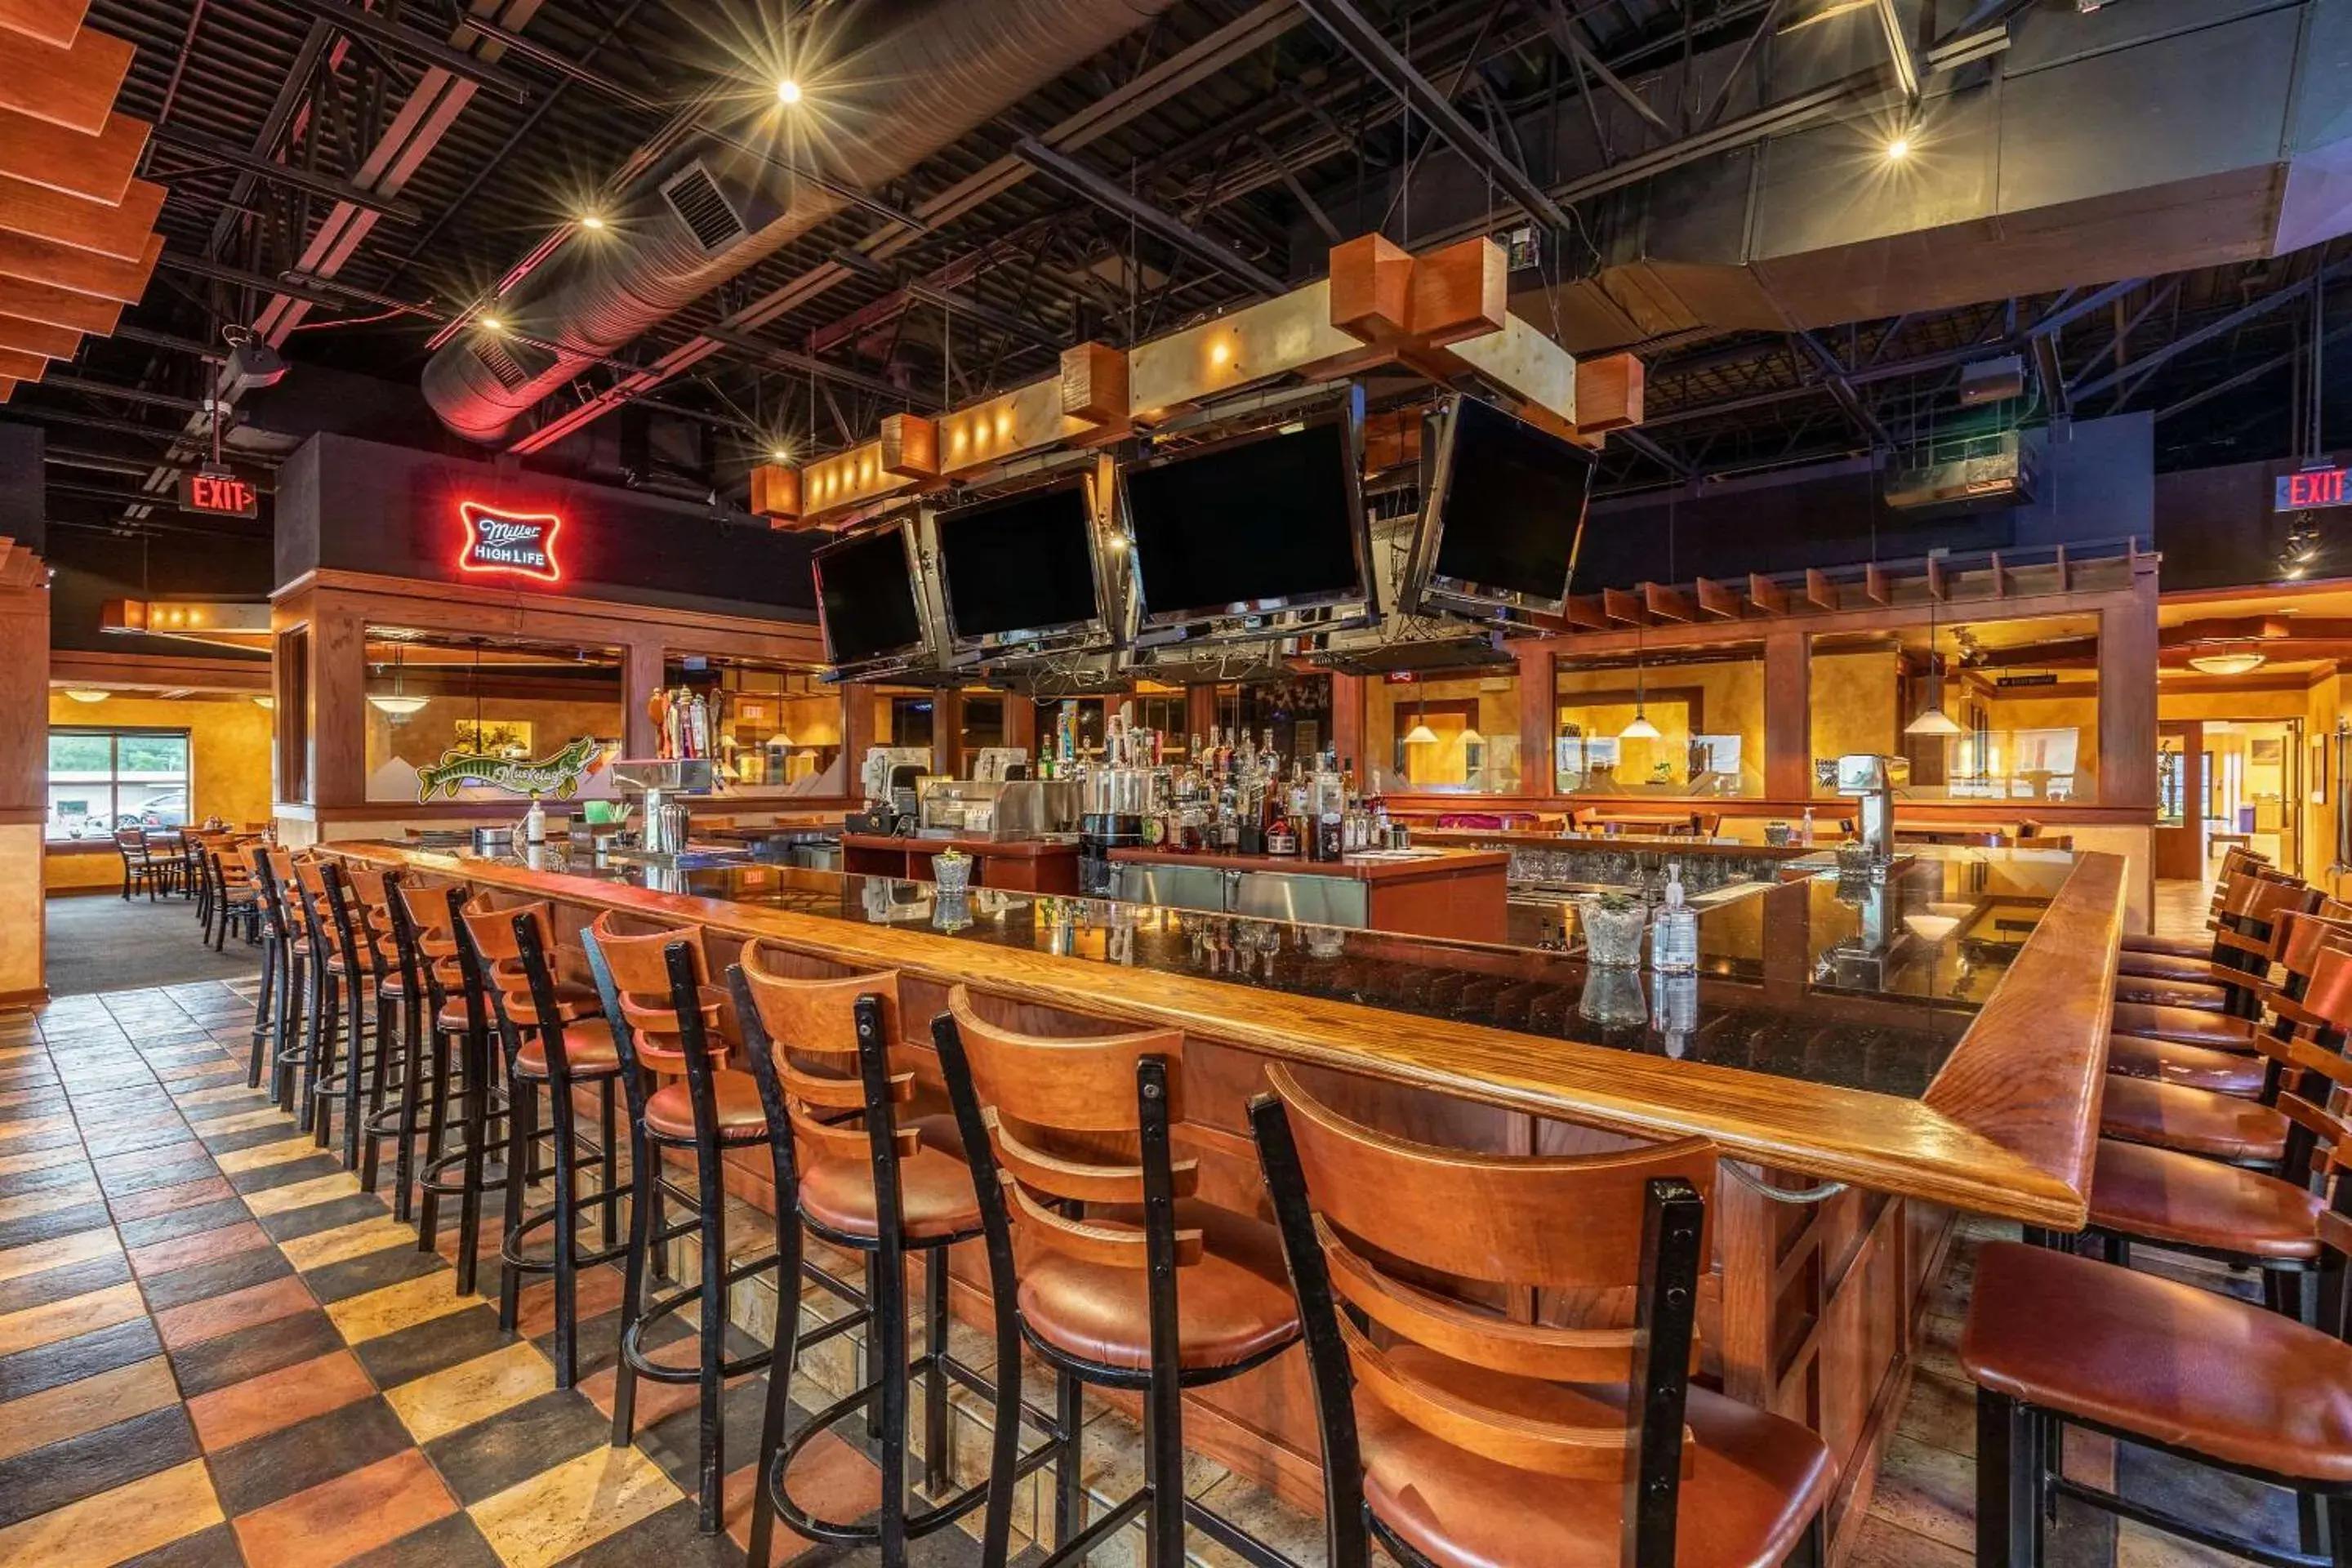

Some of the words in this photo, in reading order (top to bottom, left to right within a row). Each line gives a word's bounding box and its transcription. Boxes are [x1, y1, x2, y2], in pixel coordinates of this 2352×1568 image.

[193, 477, 244, 511] EXIT
[2290, 470, 2346, 504] EXIT
[479, 519, 541, 541] Miller
[474, 545, 511, 562] HIGH
[513, 550, 546, 565] LIFE
